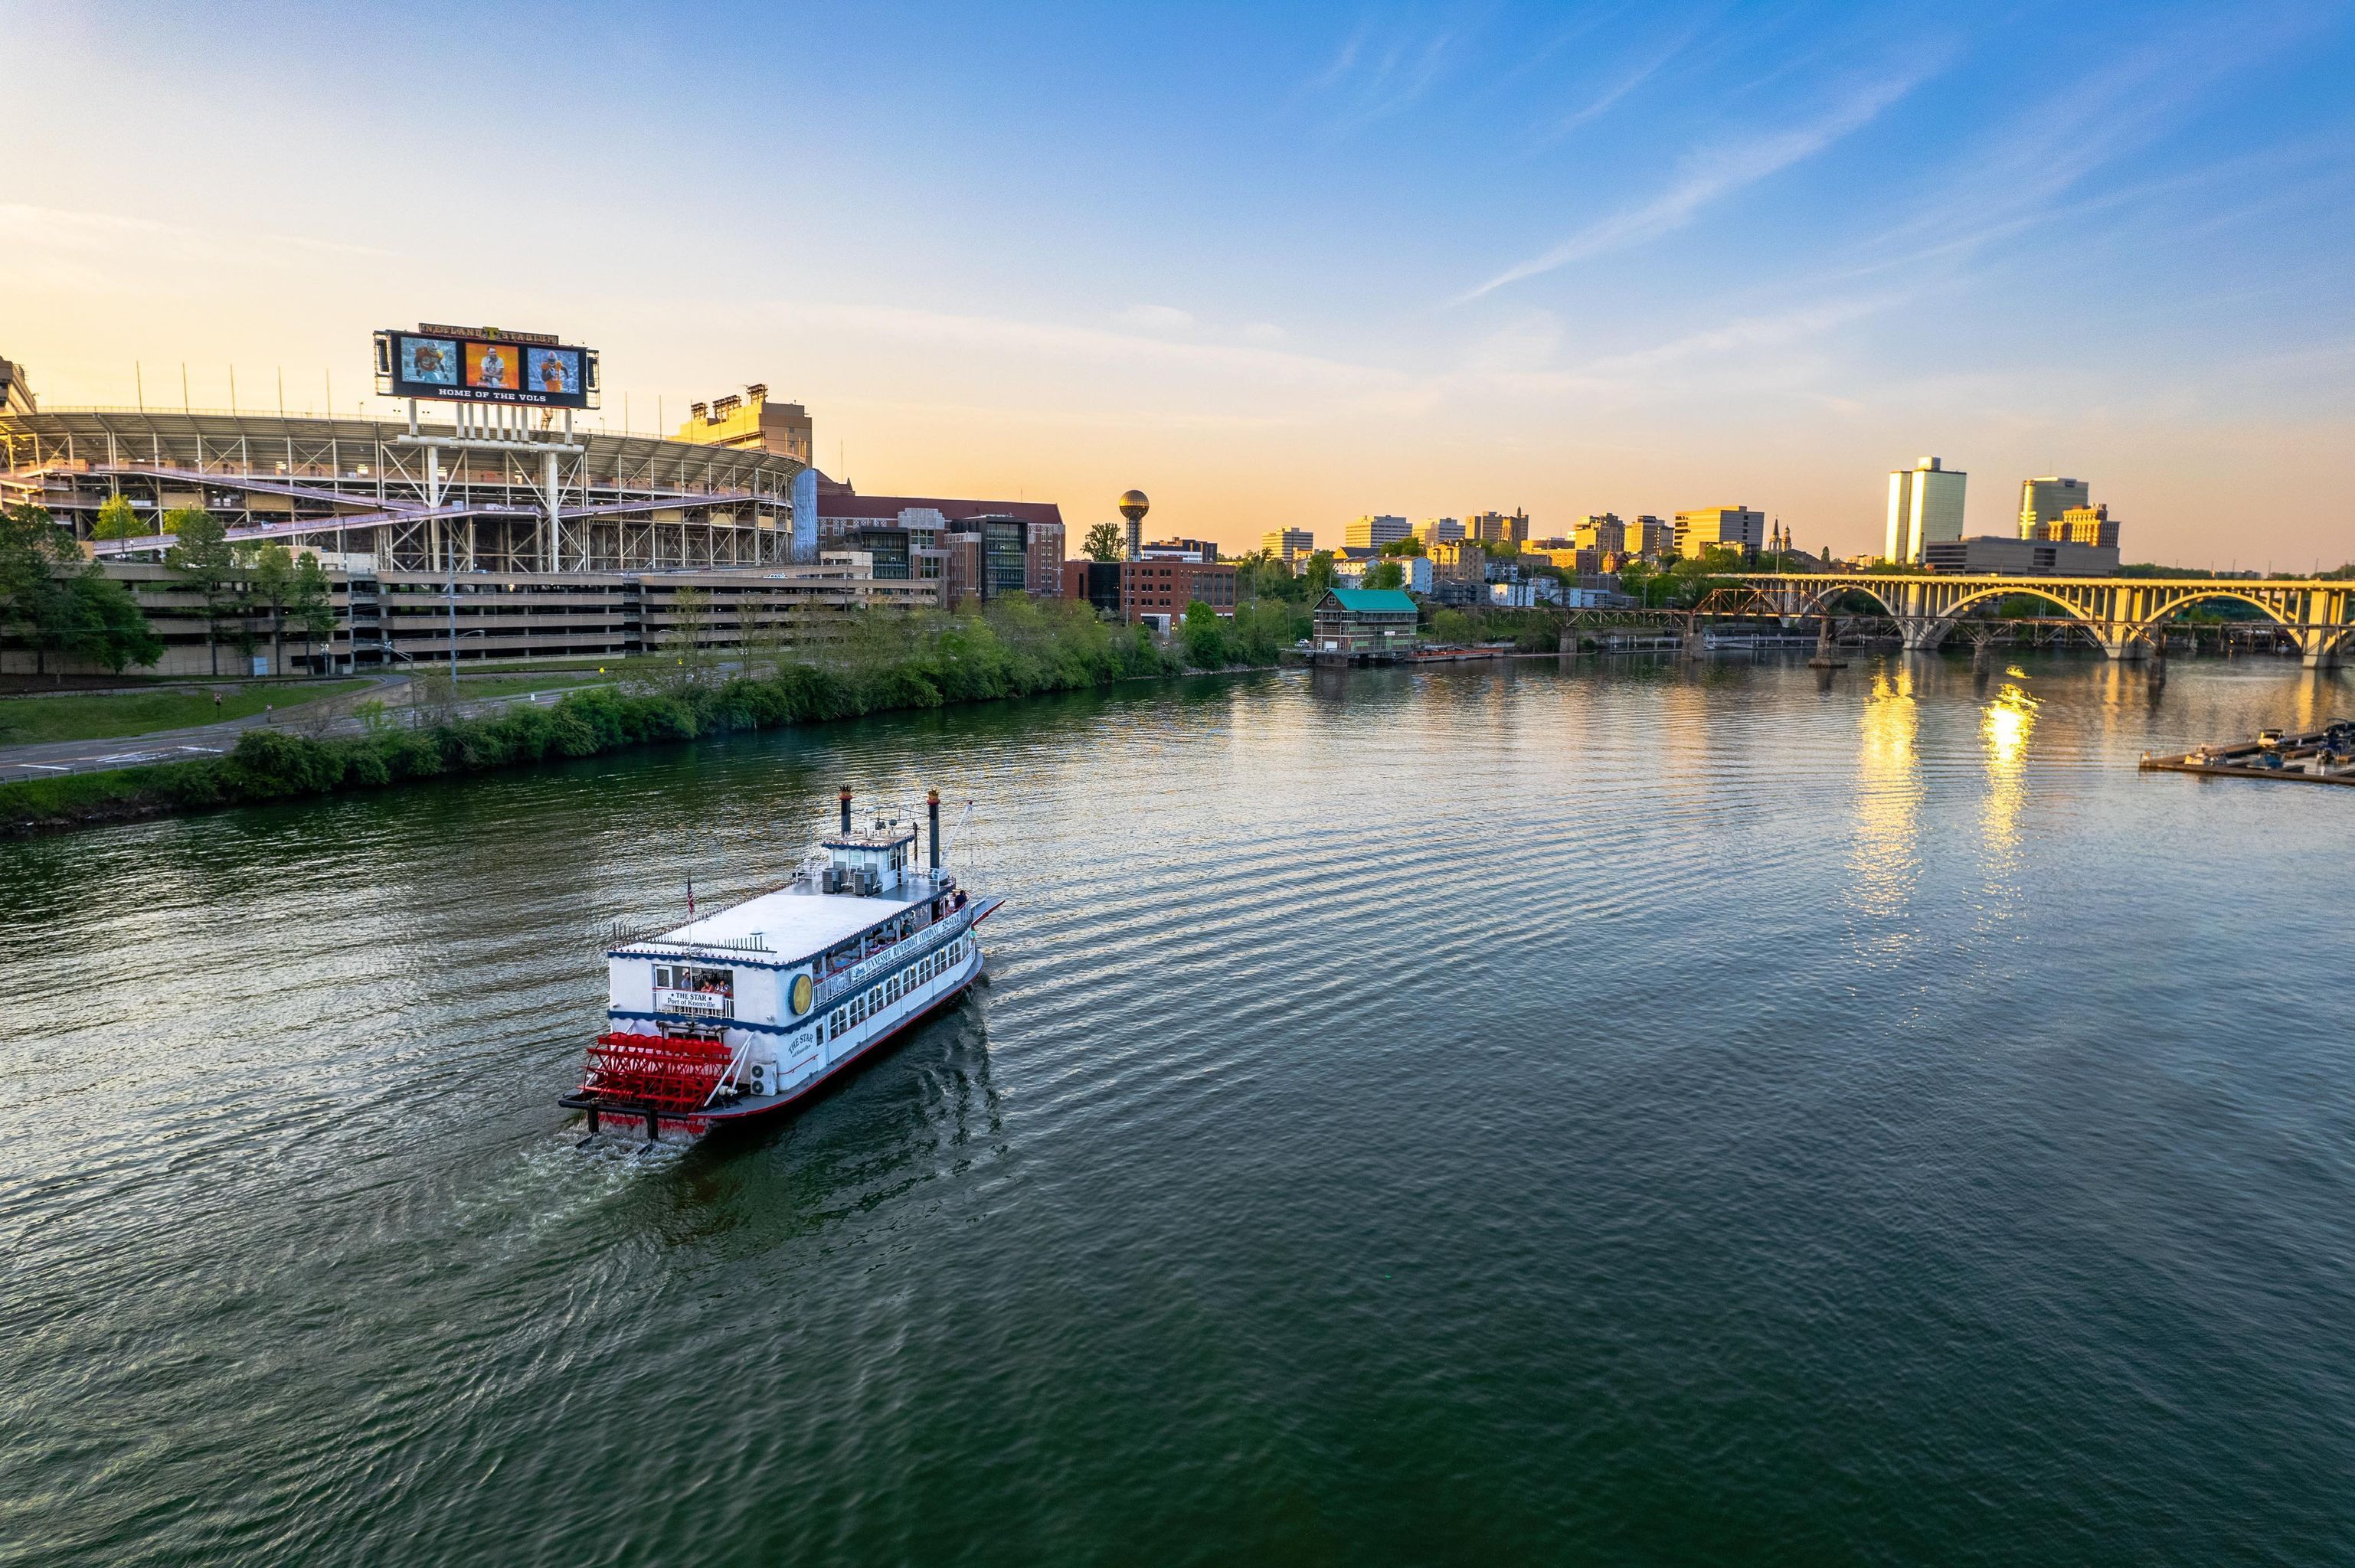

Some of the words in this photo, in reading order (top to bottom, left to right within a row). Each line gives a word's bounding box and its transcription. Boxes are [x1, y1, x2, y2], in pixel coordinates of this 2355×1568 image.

[425, 326, 482, 337] NEYLAND
[502, 332, 555, 343] STADIUM
[865, 949, 891, 971] TENNESSEE
[893, 938, 917, 956] RIVERBOAT
[919, 926, 939, 942] COMPANY
[788, 1038, 799, 1054] THE
[800, 1034, 813, 1043] STAR
